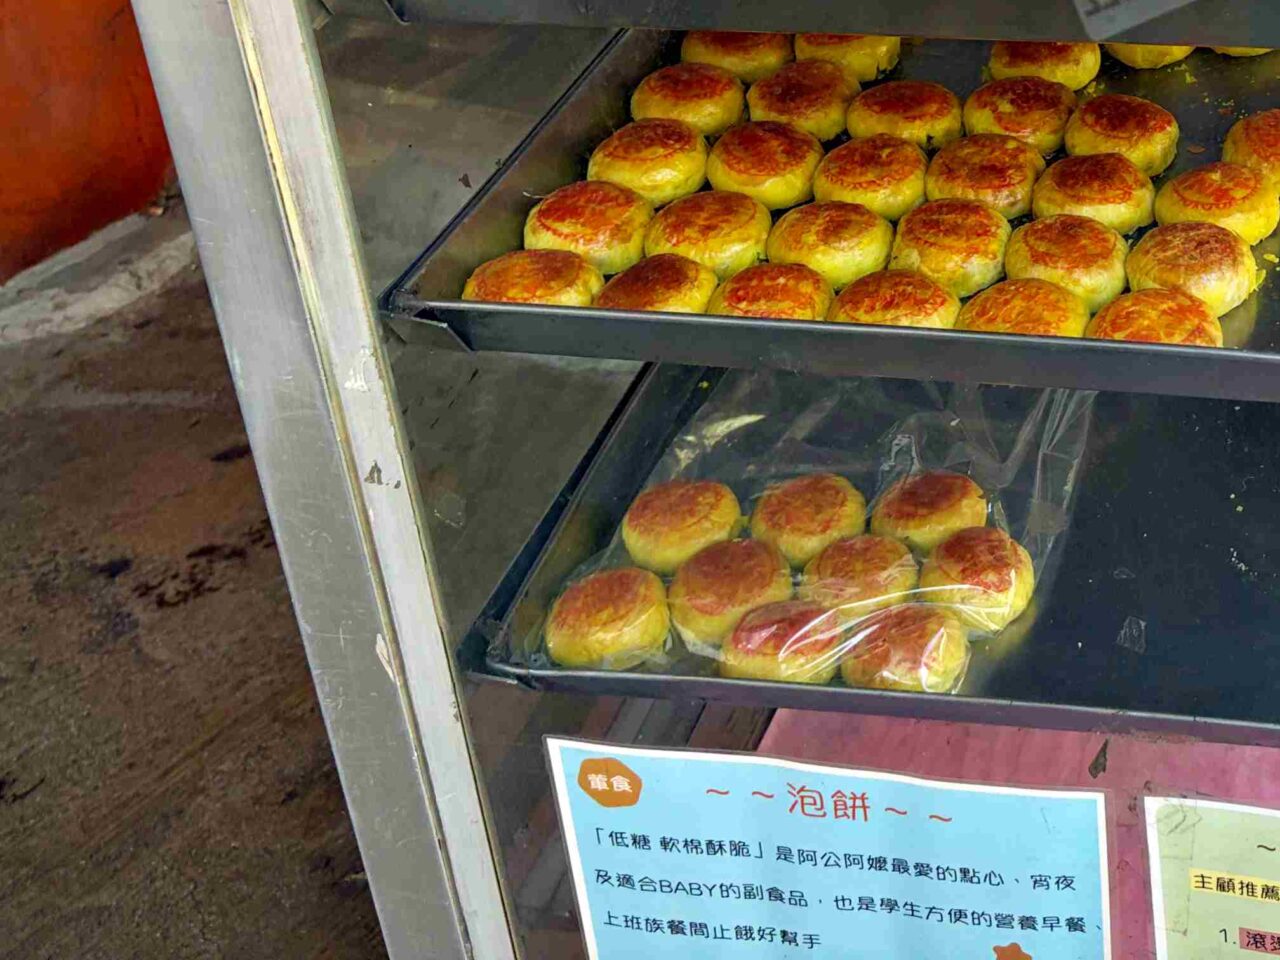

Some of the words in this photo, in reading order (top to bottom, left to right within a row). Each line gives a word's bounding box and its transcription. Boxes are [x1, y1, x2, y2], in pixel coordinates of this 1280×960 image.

[603, 909, 822, 950] 上班族餐間止餓好幫手
[1218, 927, 1238, 945] 1.
